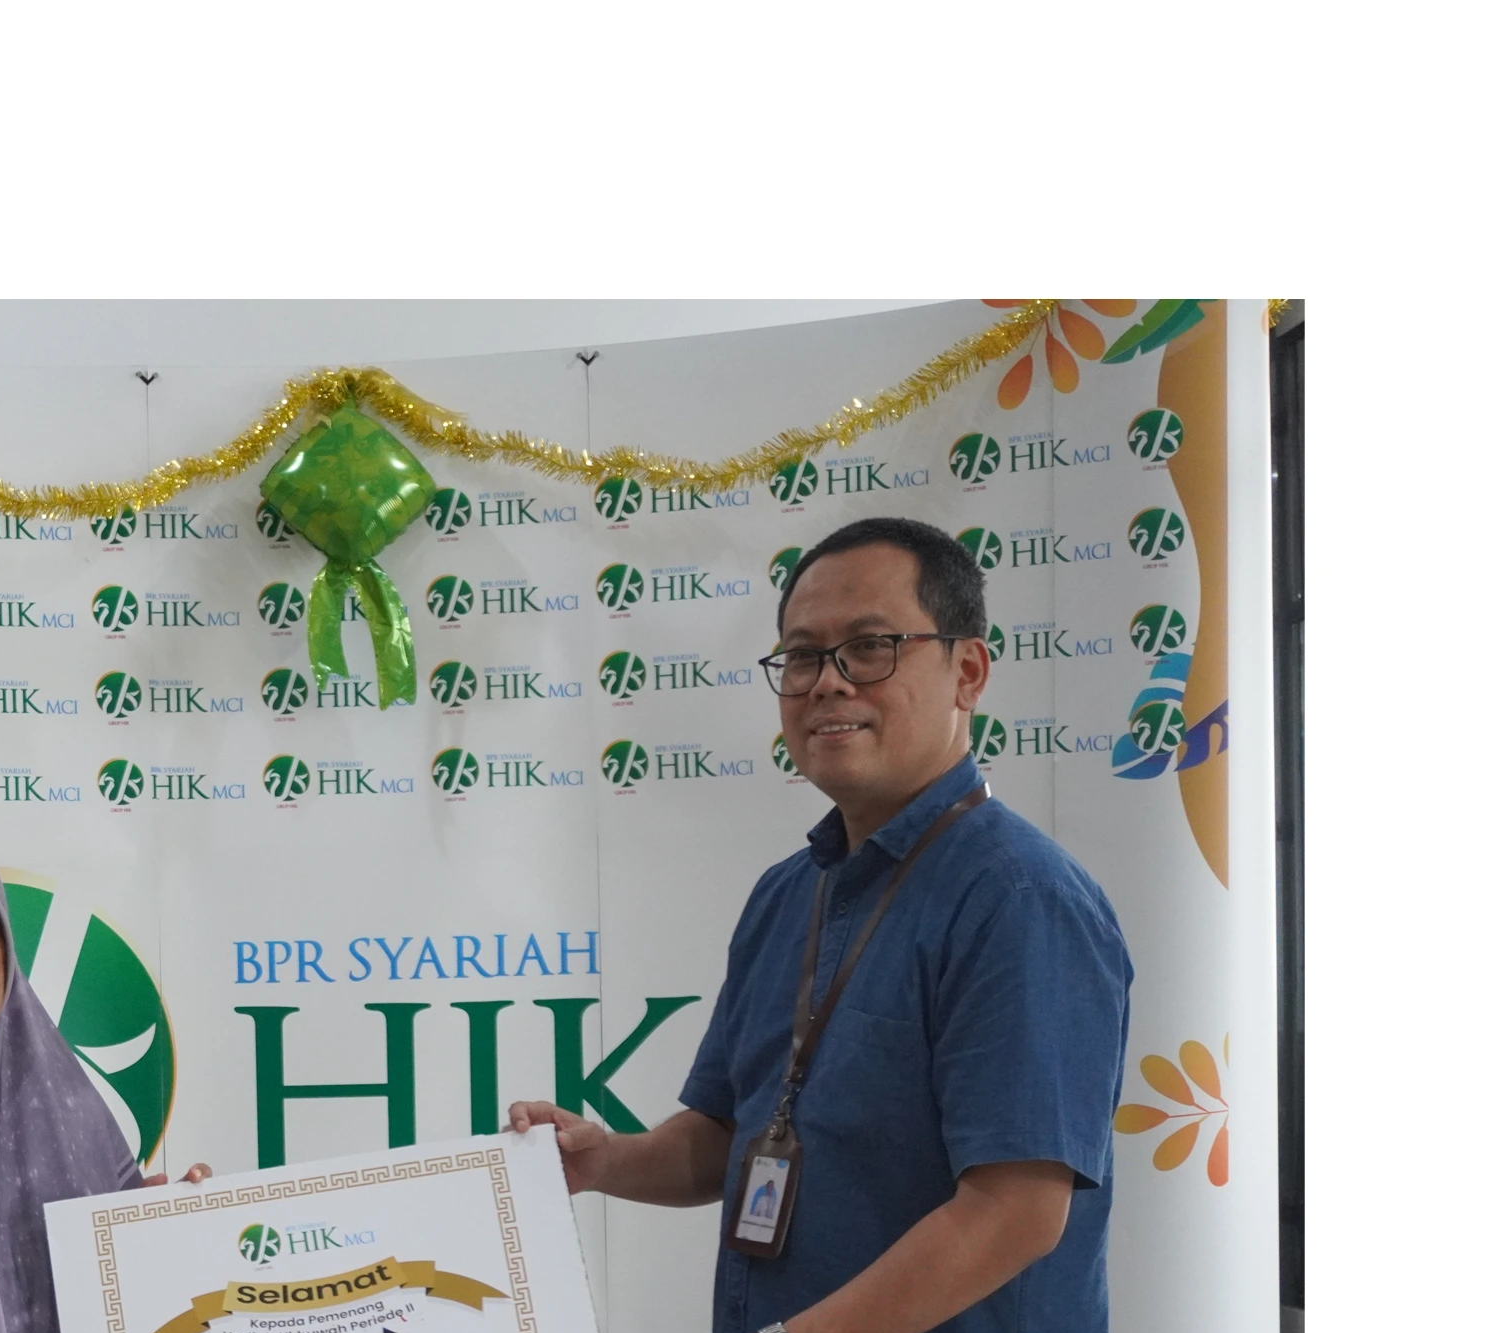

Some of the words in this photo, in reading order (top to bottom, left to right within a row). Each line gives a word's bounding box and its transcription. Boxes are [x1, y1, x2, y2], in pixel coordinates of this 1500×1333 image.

[827, 463, 890, 494] HIK
[894, 472, 928, 486] MCI
[652, 574, 712, 602] HIK
[716, 581, 749, 596] MCI
[42, 614, 74, 628] MCI
[656, 752, 717, 779] HIK
[720, 760, 753, 775] MCI
[318, 770, 378, 794] HIK
[381, 779, 413, 793] MCI
[234, 939, 336, 984] BPR
[349, 931, 601, 982] SYARIAH
[234, 996, 702, 1170] HIK
[287, 1226, 343, 1255] HIK
[344, 1231, 375, 1247] MCI
[237, 1265, 392, 1304] Selamat
[251, 1317, 305, 1330] Kepada
[309, 1301, 384, 1324] Pemenang
[351, 1309, 403, 1331] Periode
[406, 1303, 414, 1312] II
